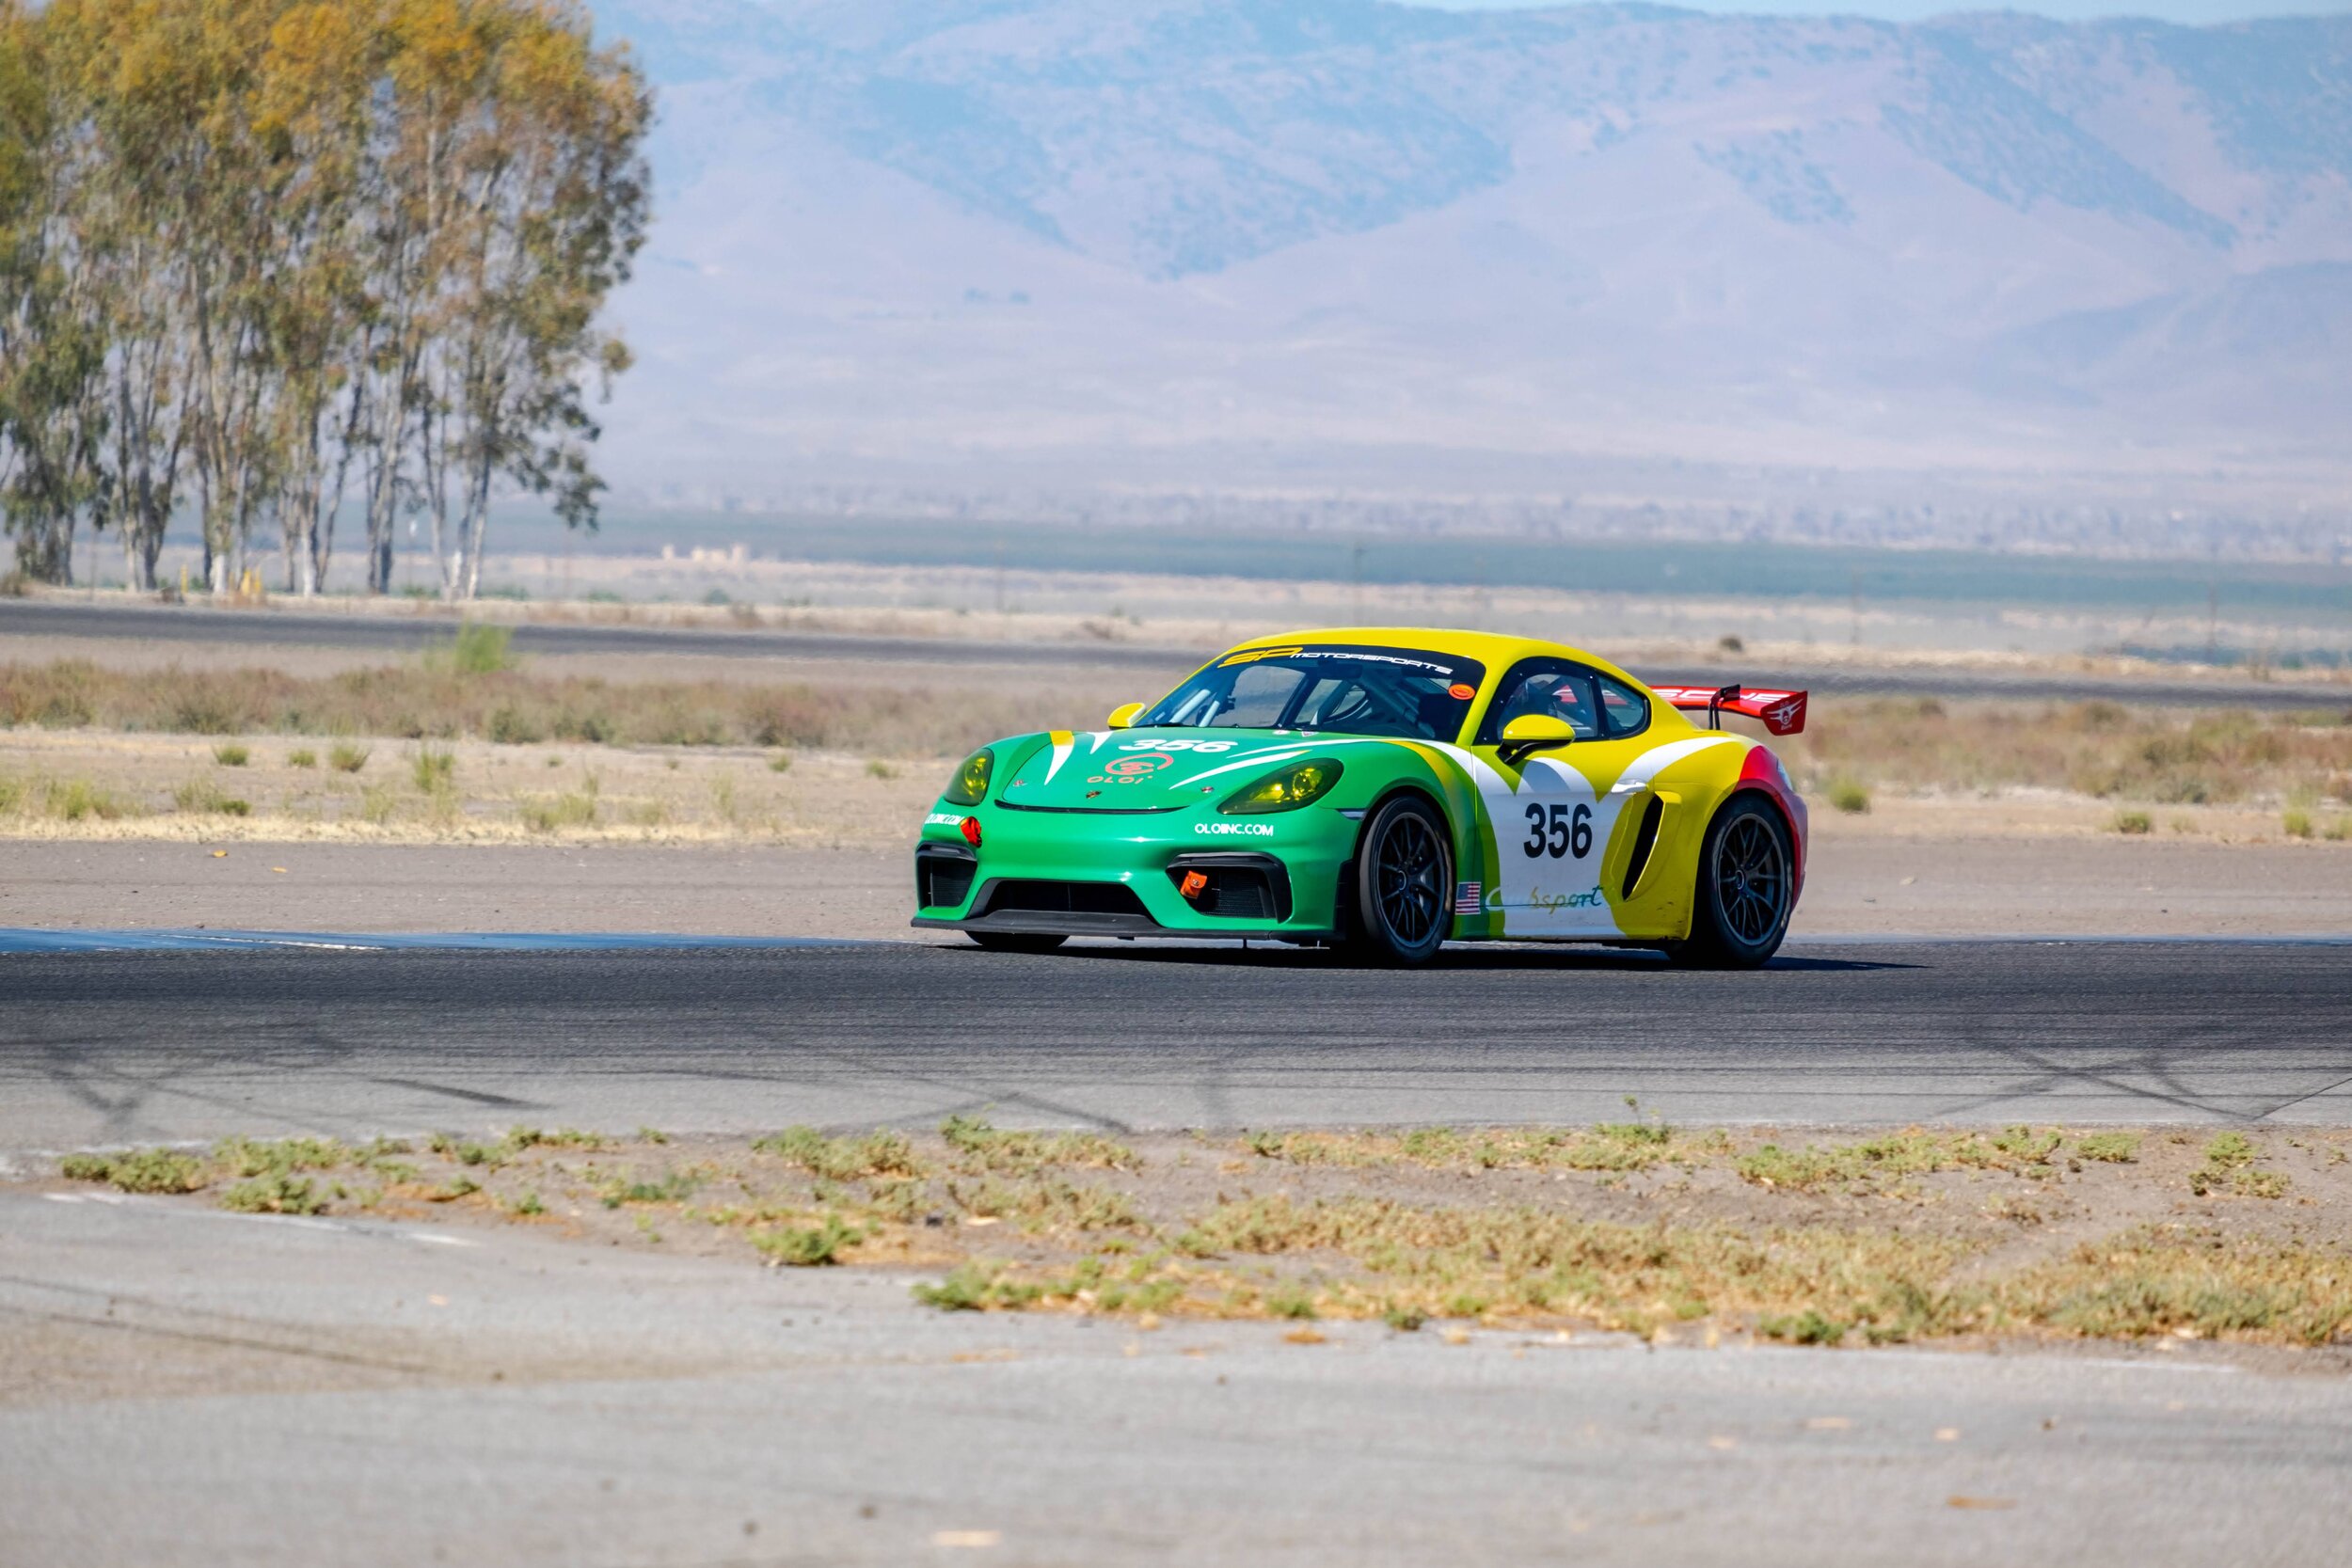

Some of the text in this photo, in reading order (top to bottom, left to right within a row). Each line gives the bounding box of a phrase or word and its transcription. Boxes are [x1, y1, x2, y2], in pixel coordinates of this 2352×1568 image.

[1290, 652, 1454, 675] MOTORSPORTS
[1118, 738, 1239, 753] 356
[1523, 802, 1593, 860] 356
